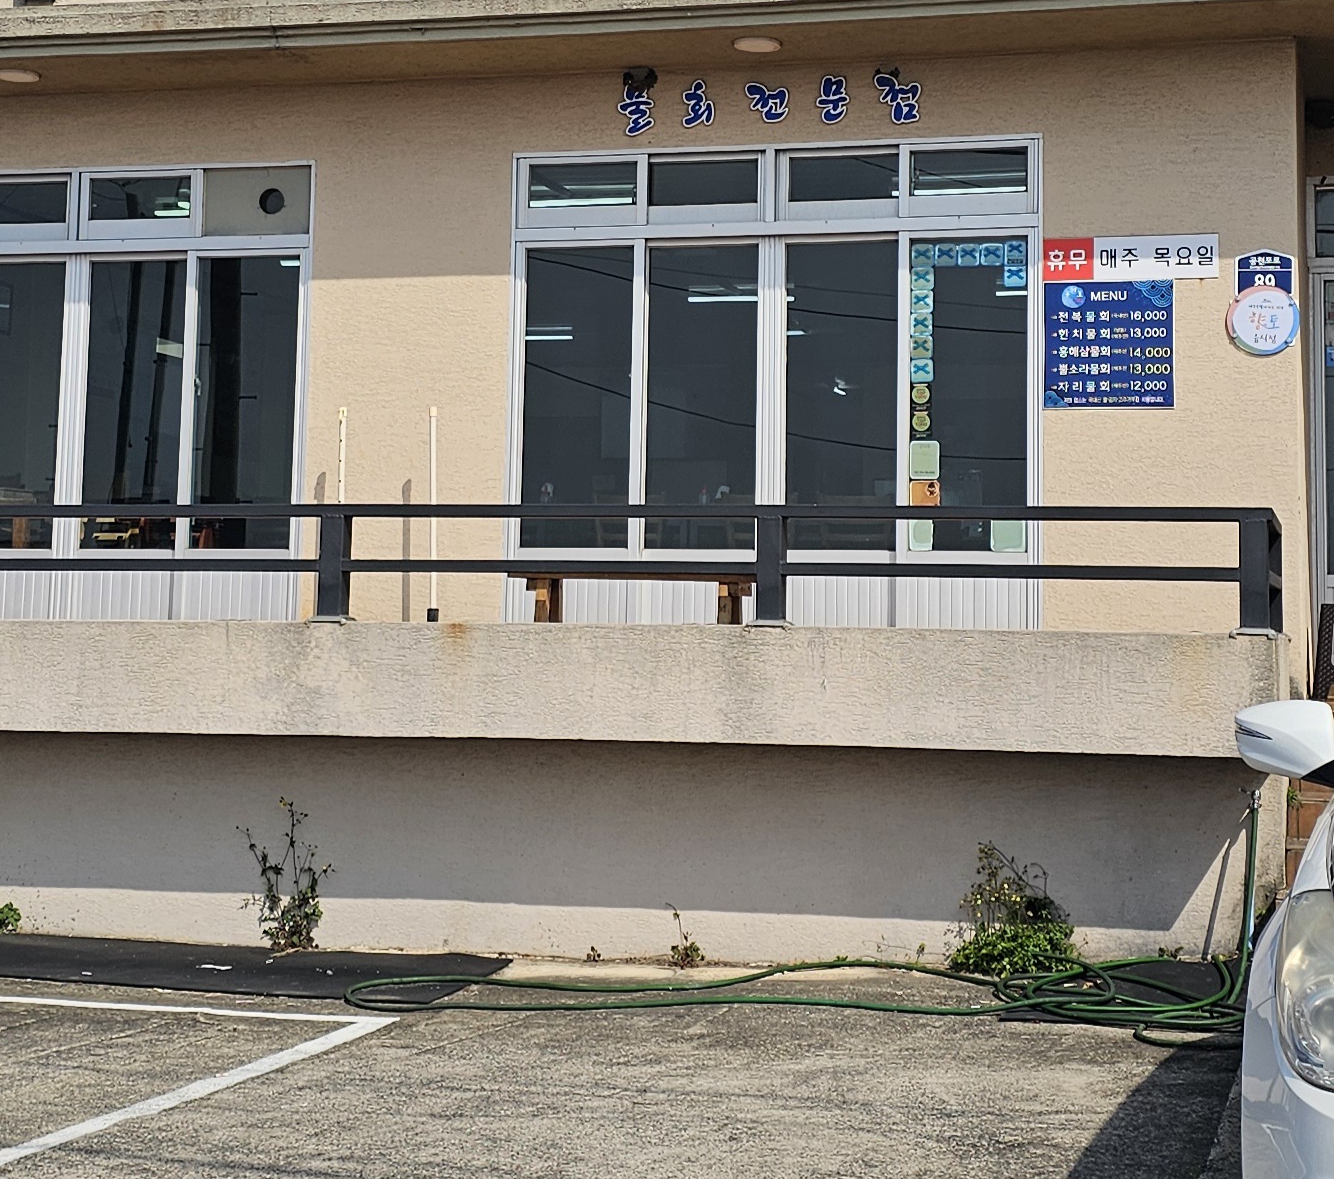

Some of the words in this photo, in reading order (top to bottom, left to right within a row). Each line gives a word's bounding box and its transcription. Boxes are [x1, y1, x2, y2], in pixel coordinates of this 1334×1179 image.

[1047, 249, 1088, 272] 휴무
[1100, 247, 1139, 268] 매주
[1154, 245, 1214, 267] 목요일
[1090, 290, 1128, 302] MENU
[1130, 310, 1167, 322] 16,000
[1130, 328, 1167, 340] 13,000
[1130, 347, 1171, 360] 14,000
[1130, 363, 1171, 376] 13,000
[1130, 380, 1167, 392] 12,000
